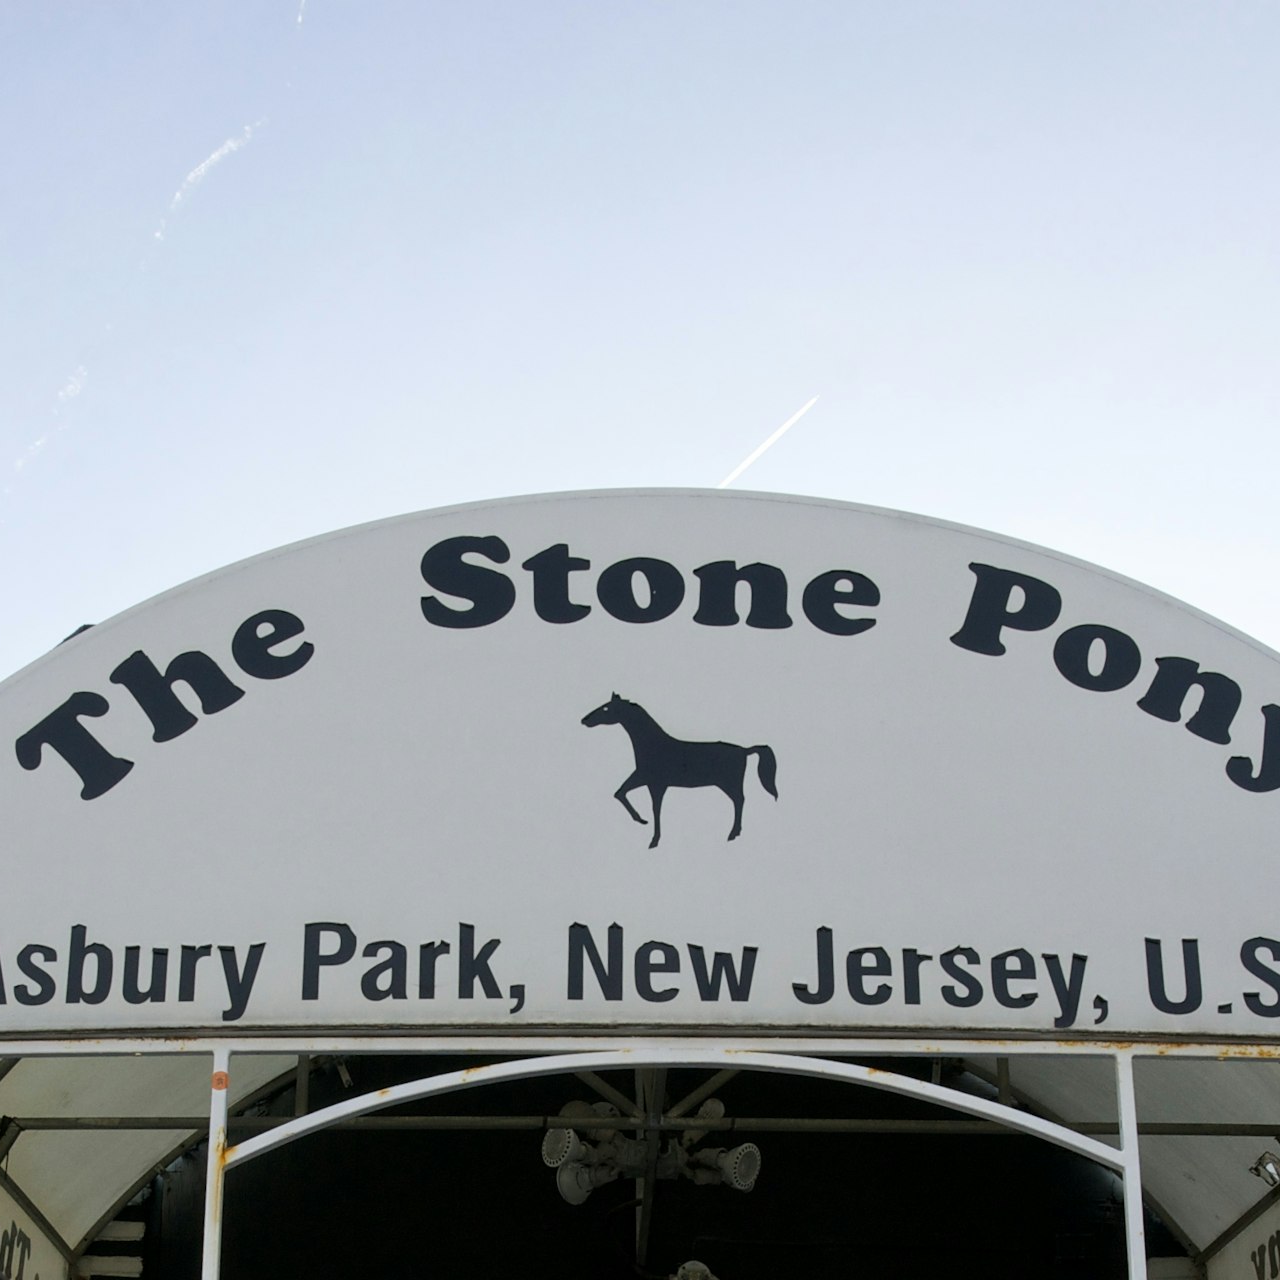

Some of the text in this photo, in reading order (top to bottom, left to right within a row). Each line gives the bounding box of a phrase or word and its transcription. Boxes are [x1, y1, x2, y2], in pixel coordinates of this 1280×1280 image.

[15, 608, 315, 801] The
[420, 534, 881, 636] Stone
[300, 921, 526, 1015] Park,
[566, 921, 759, 1003] New
[791, 925, 1110, 1029] Jersey,
